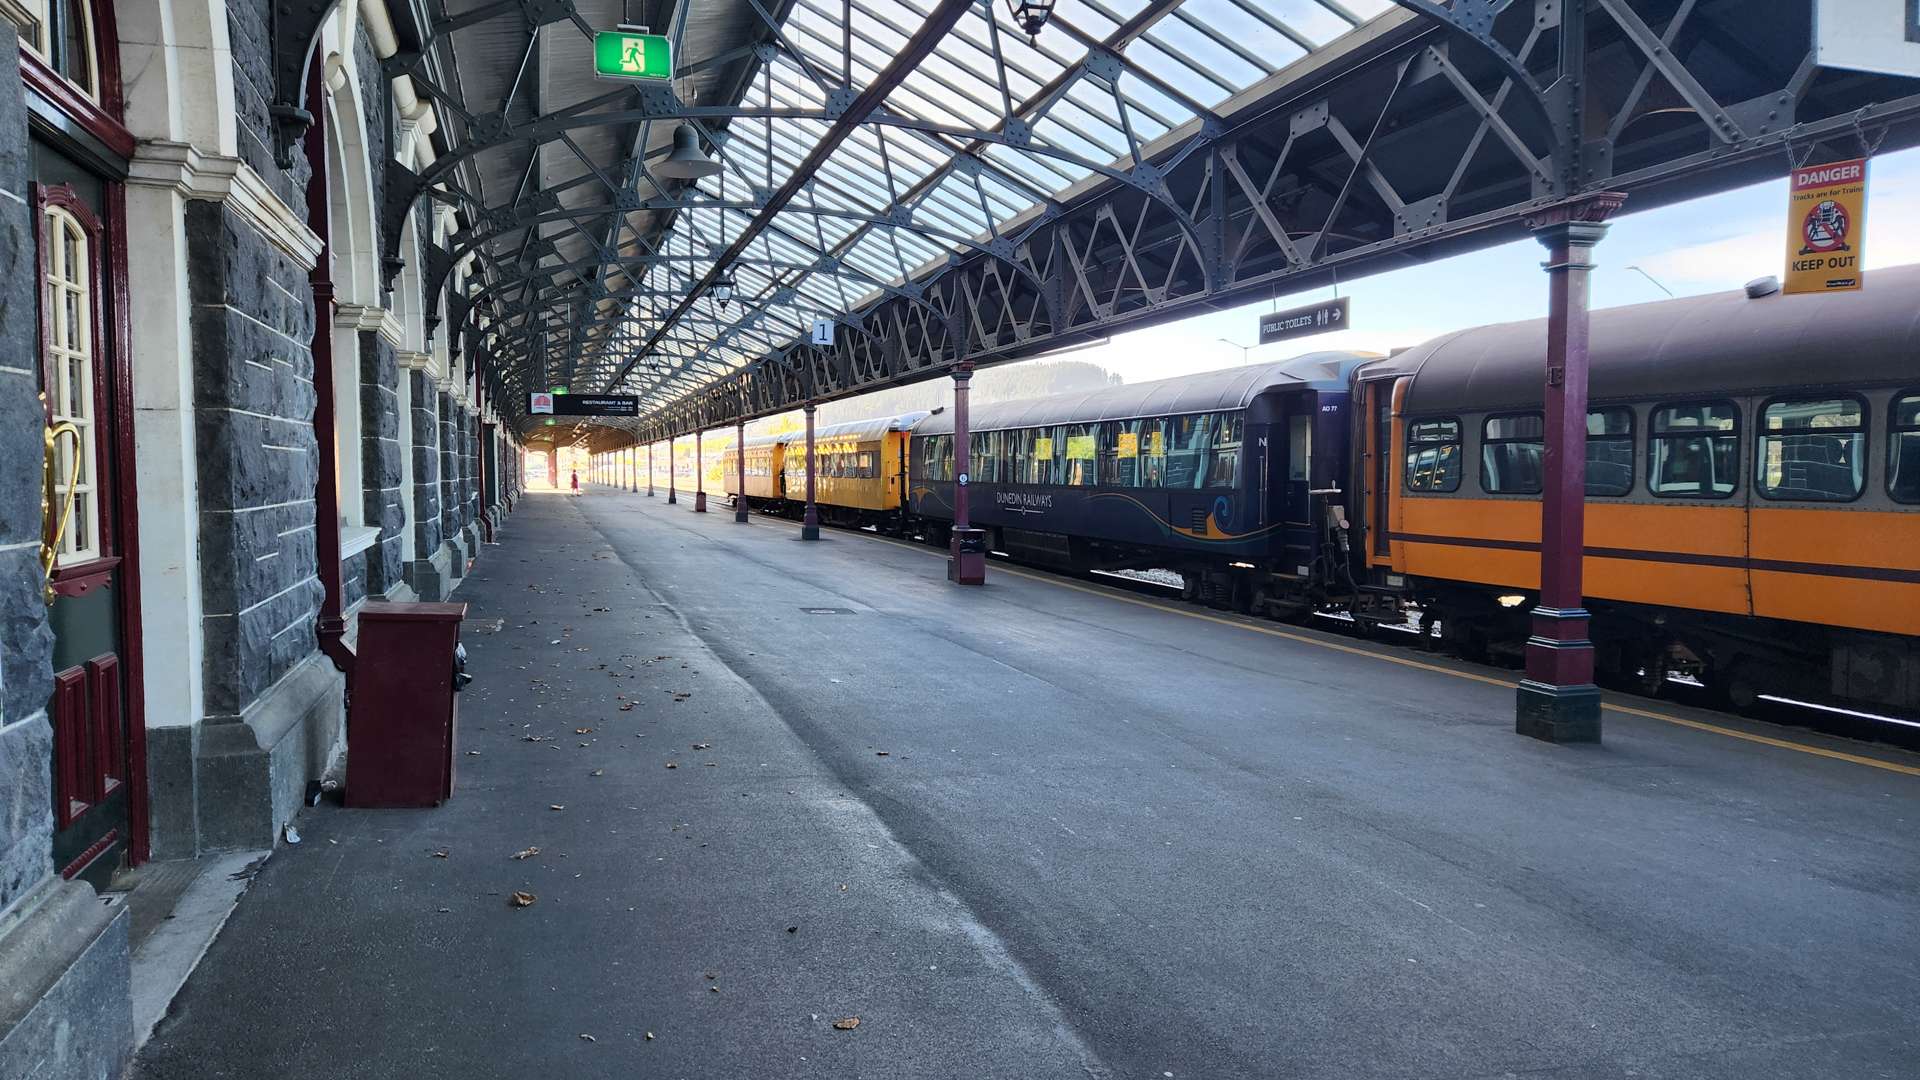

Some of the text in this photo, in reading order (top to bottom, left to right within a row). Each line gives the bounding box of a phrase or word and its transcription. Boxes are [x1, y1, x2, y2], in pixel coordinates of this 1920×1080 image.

[1798, 165, 1860, 186] DANGER
[1793, 192, 1814, 201] Tracks
[1829, 189, 1840, 197] for
[1792, 256, 1855, 271] KEEP OUT
[819, 323, 828, 341] 1
[1263, 315, 1312, 333] PUBLIC TOILETS
[996, 491, 1052, 508] DUNEDIN RAILWAYS
